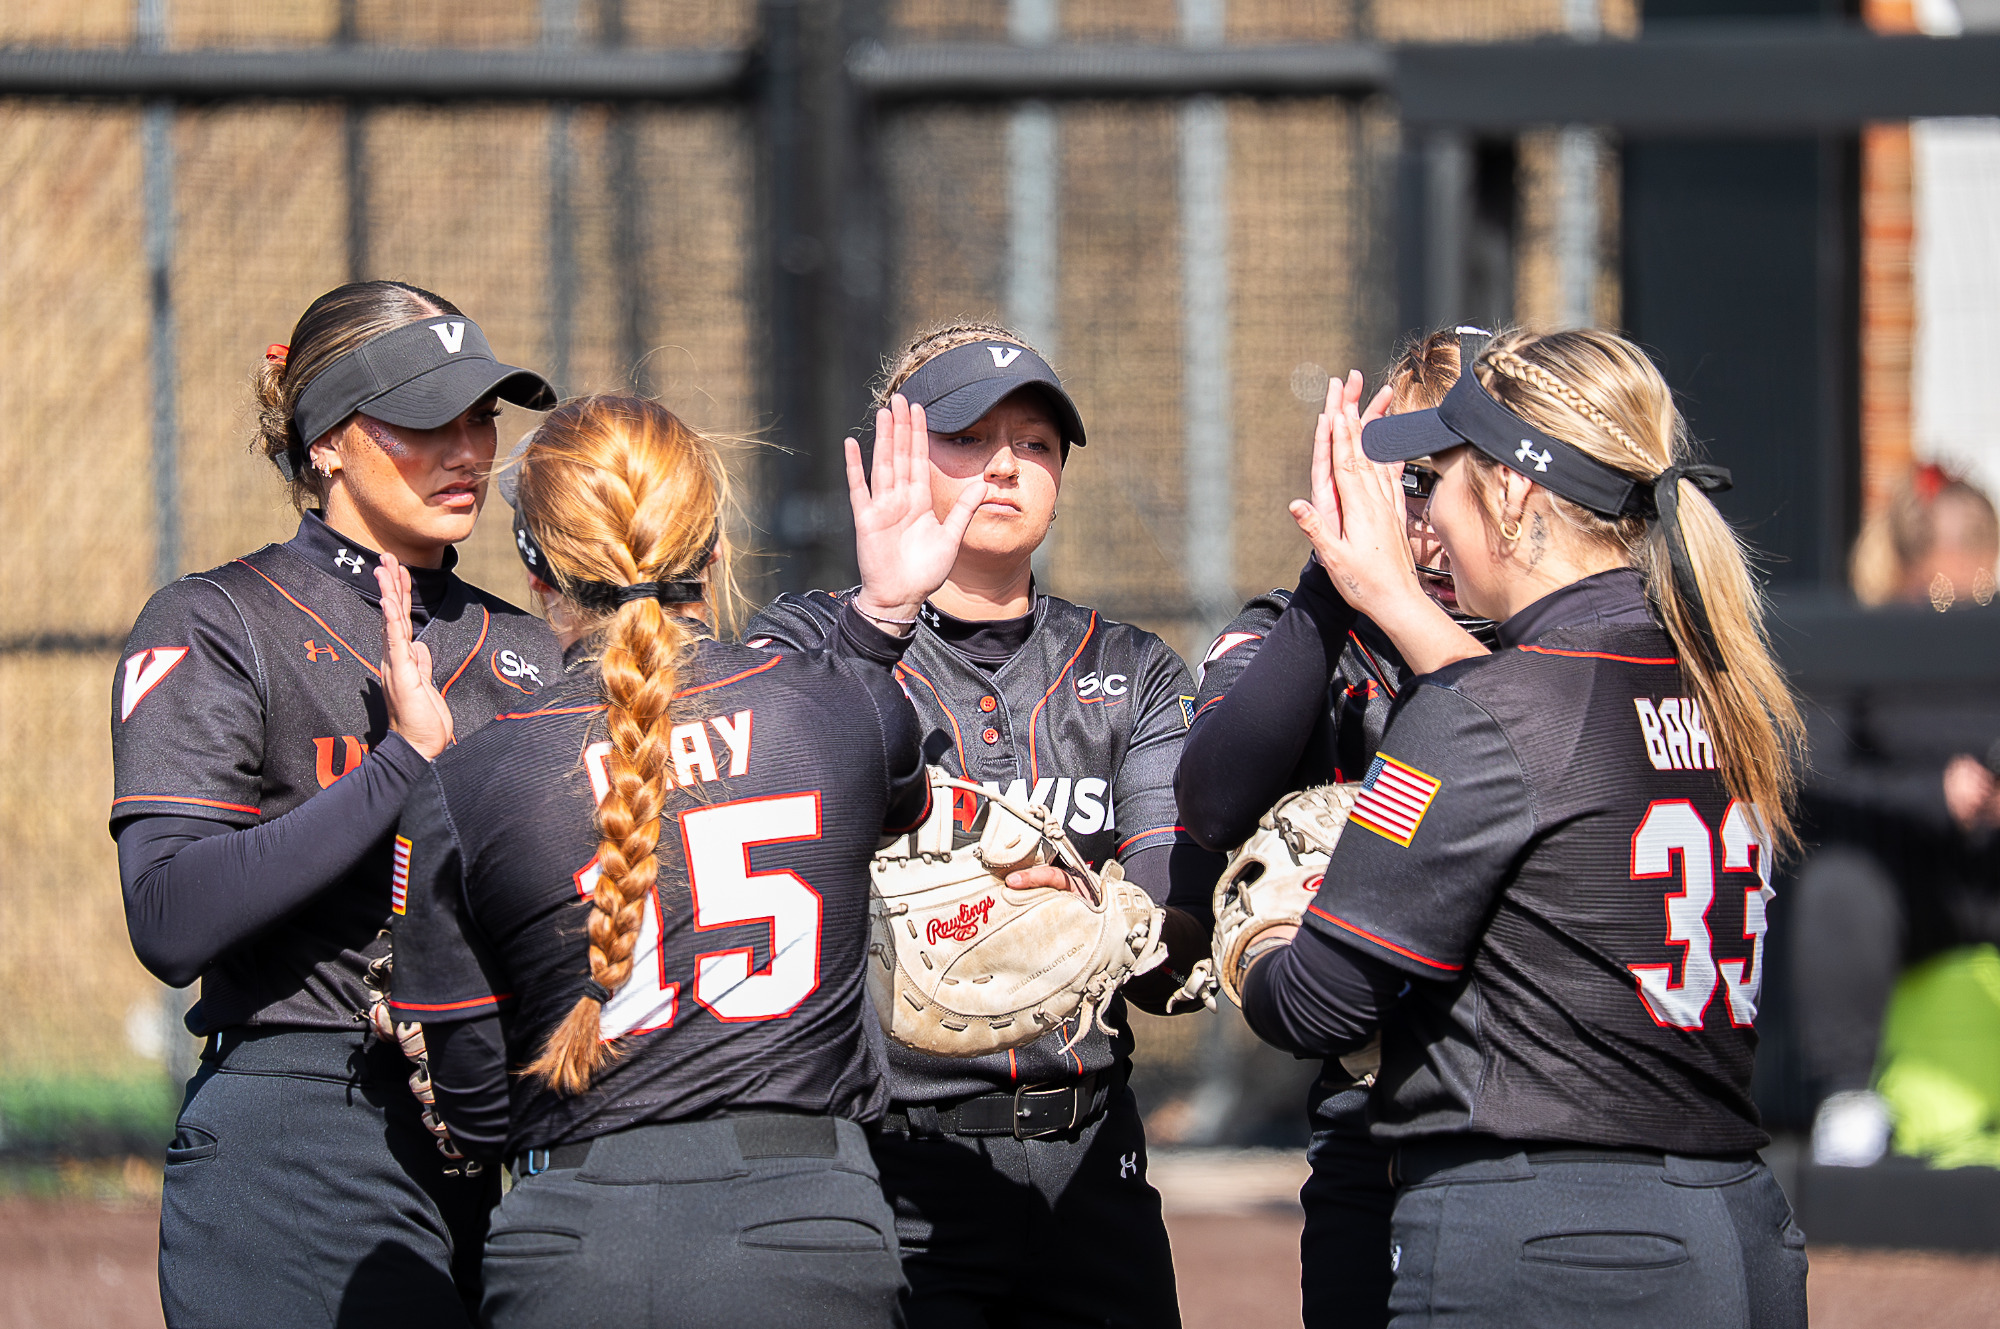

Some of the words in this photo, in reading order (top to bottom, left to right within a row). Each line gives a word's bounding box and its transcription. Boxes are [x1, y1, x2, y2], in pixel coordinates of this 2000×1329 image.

[428, 321, 466, 354] V
[986, 345, 1022, 368] V
[120, 645, 190, 723] V
[1634, 697, 1721, 770] BAK
[982, 777, 1116, 835] WIS
[926, 895, 996, 946] Rawlings
[1627, 797, 1776, 1032] 33
